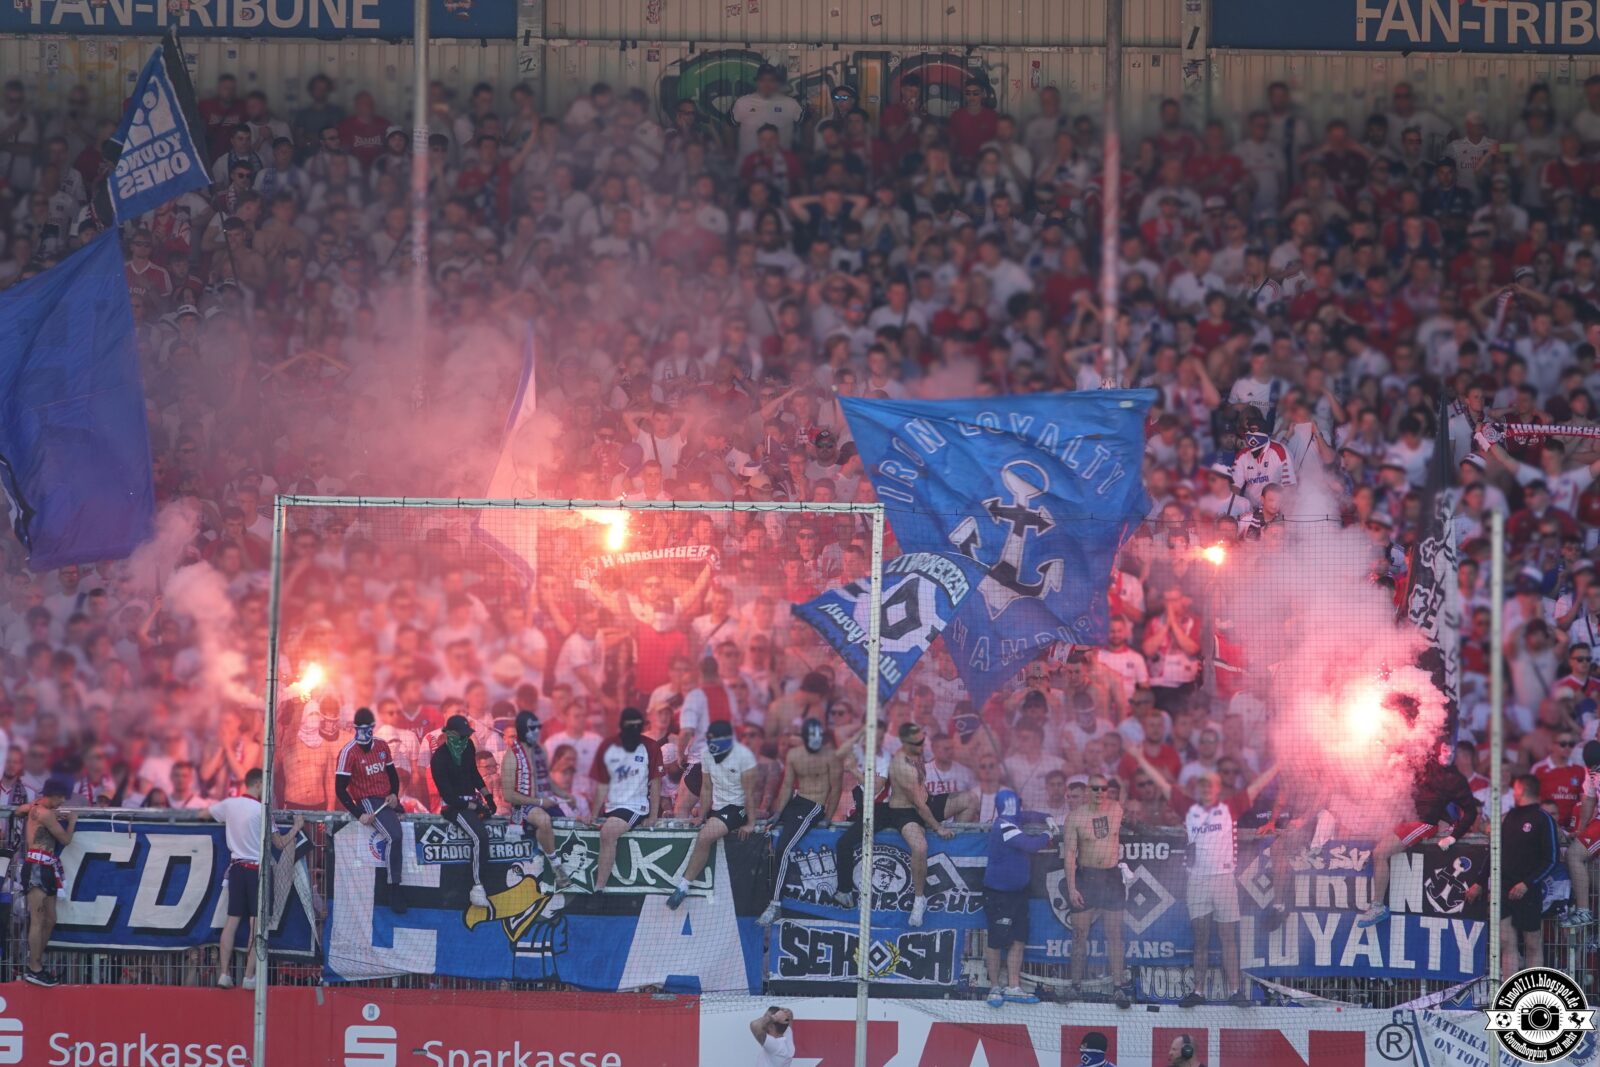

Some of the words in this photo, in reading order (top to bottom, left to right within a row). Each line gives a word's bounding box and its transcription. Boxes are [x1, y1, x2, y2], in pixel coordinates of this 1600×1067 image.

[1355, 0, 1600, 45] FAN-TRIB
[952, 410, 1126, 495] LOYALTY
[600, 544, 712, 569] HAMBURGER
[365, 761, 385, 776] HSV
[424, 842, 531, 860] STADIOERBOT
[1239, 911, 1486, 974] LOYALTY
[48, 1032, 248, 1067] Sparkasse
[422, 1040, 623, 1067] Sparkasse
